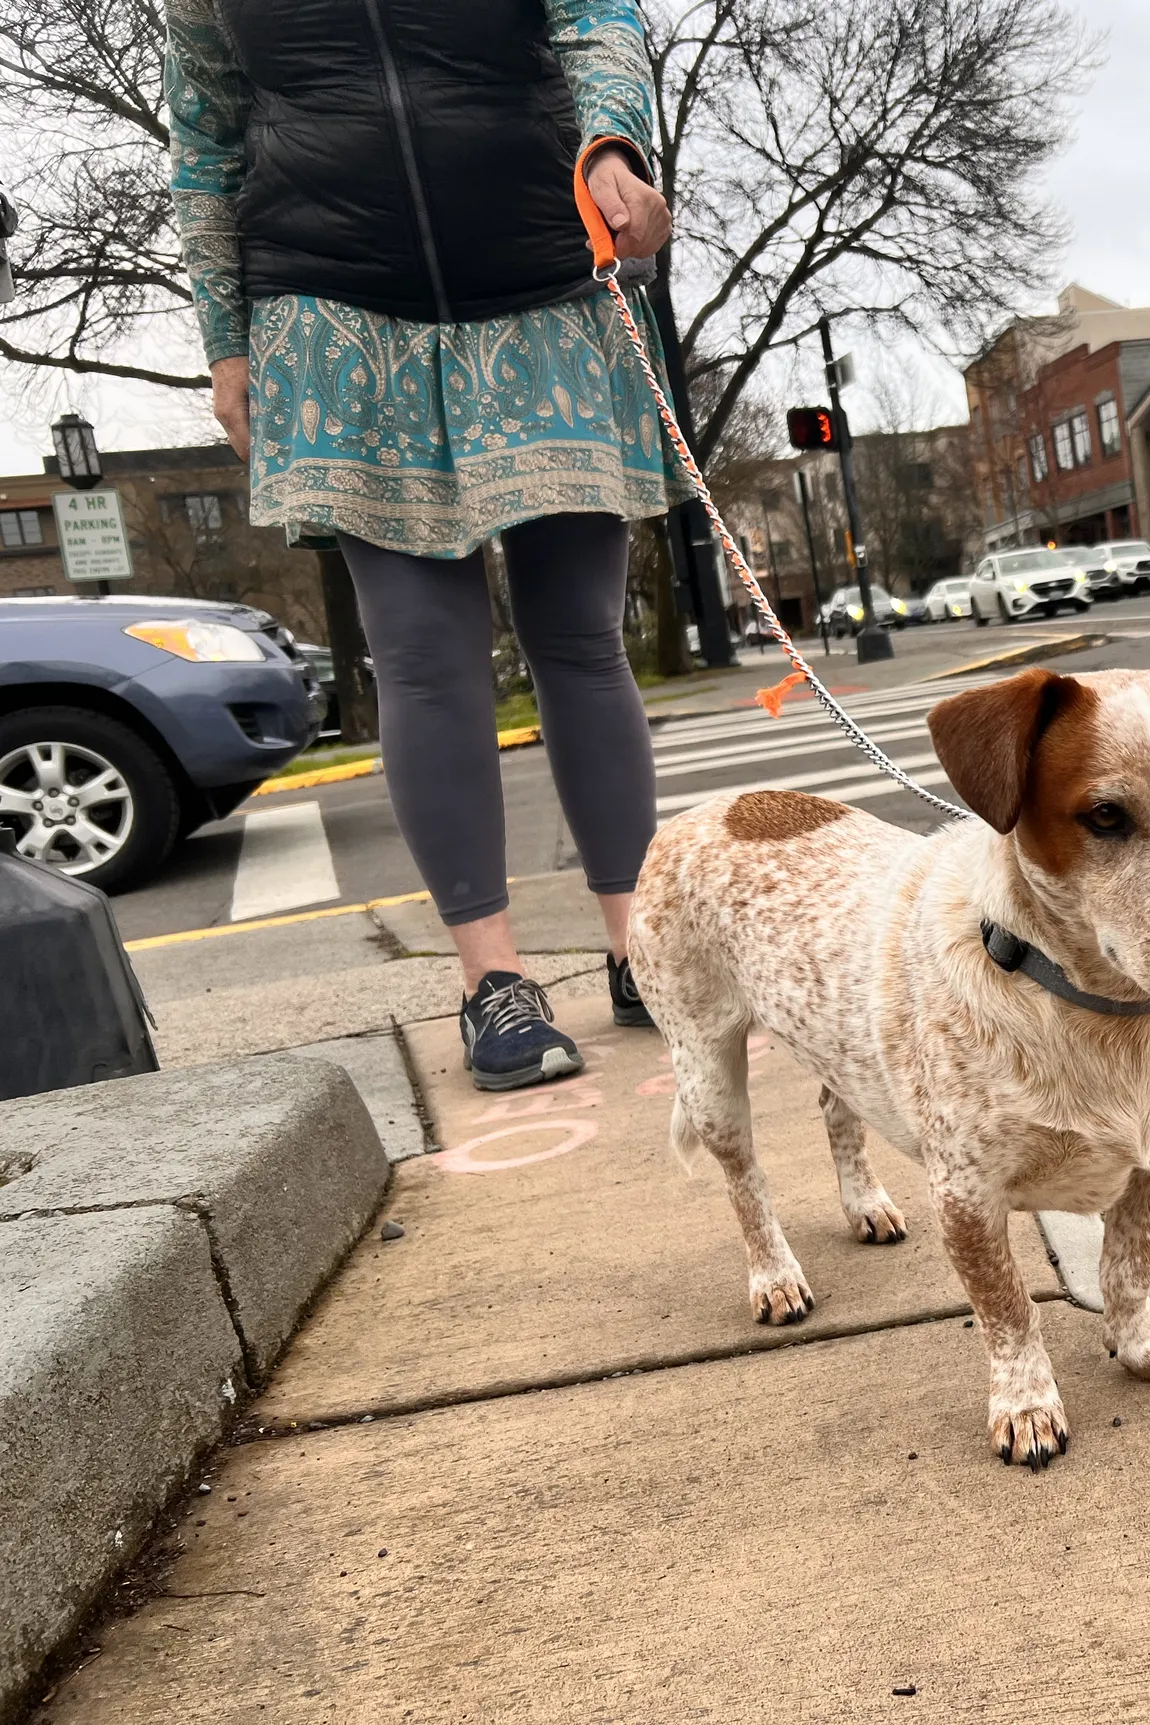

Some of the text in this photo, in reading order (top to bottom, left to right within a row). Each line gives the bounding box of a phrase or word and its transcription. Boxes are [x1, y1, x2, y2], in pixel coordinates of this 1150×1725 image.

[68, 495, 107, 511] 4 HR
[64, 518, 117, 532] PARKING
